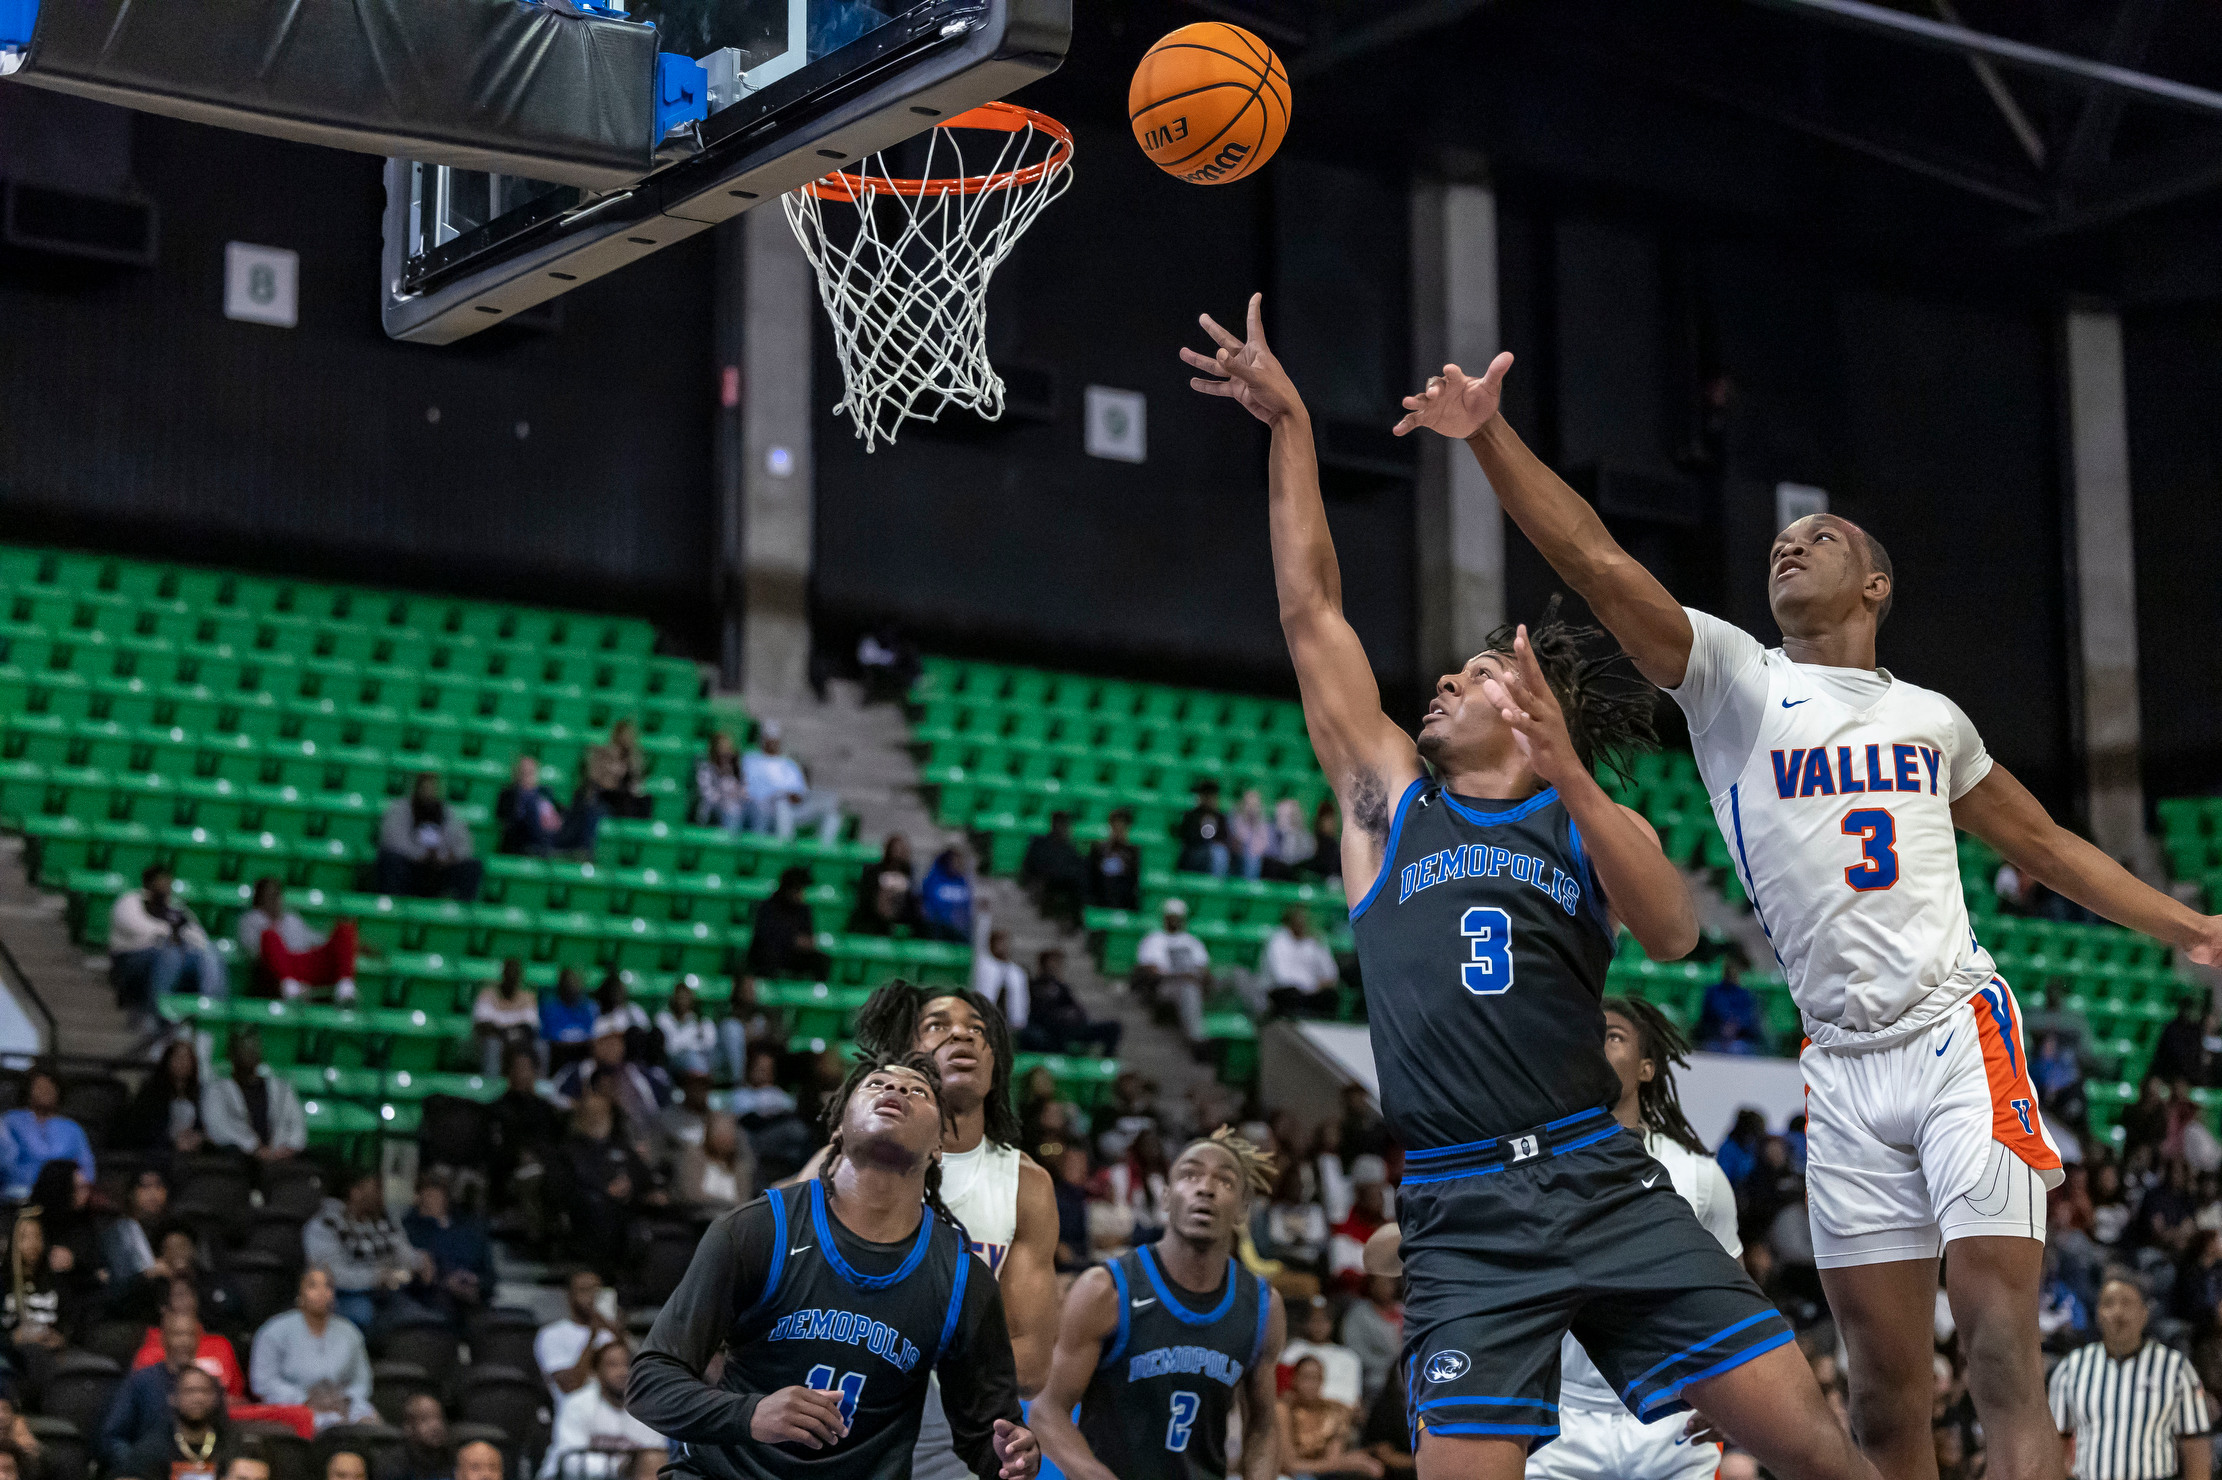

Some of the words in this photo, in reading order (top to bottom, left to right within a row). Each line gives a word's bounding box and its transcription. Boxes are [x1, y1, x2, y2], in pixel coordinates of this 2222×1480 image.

[1770, 743, 1941, 799] VALLEY
[1399, 844, 1580, 916] DEMOPOLIS
[1841, 807, 1899, 892] 3
[1460, 907, 1514, 995] 3
[768, 1309, 921, 1374] DEMOPOLIS
[1128, 1345, 1244, 1388] DEMOPOLI
[1165, 1390, 1201, 1453] 2
